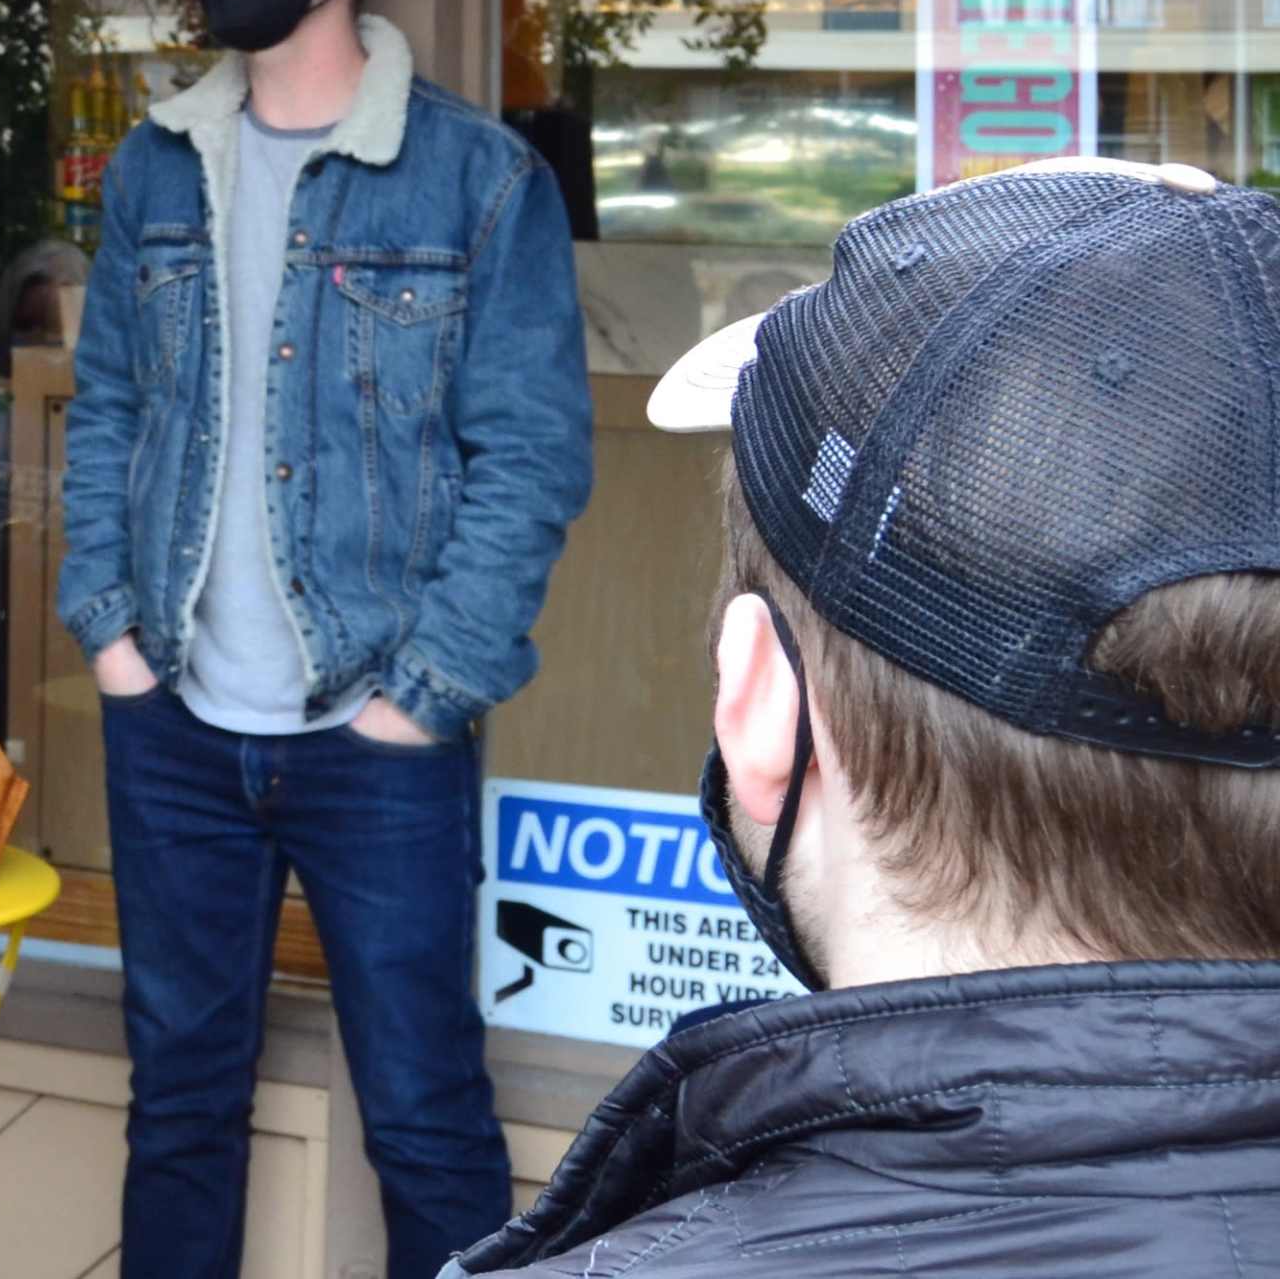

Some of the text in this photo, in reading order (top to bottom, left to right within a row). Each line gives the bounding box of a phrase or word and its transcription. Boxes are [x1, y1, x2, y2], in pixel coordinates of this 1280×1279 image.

[510, 811, 736, 896] NOTIC
[626, 907, 687, 935] THIS
[648, 942, 781, 978] UNDER 24
[630, 972, 705, 1002] HOUR
[610, 1002, 682, 1029] SURV
